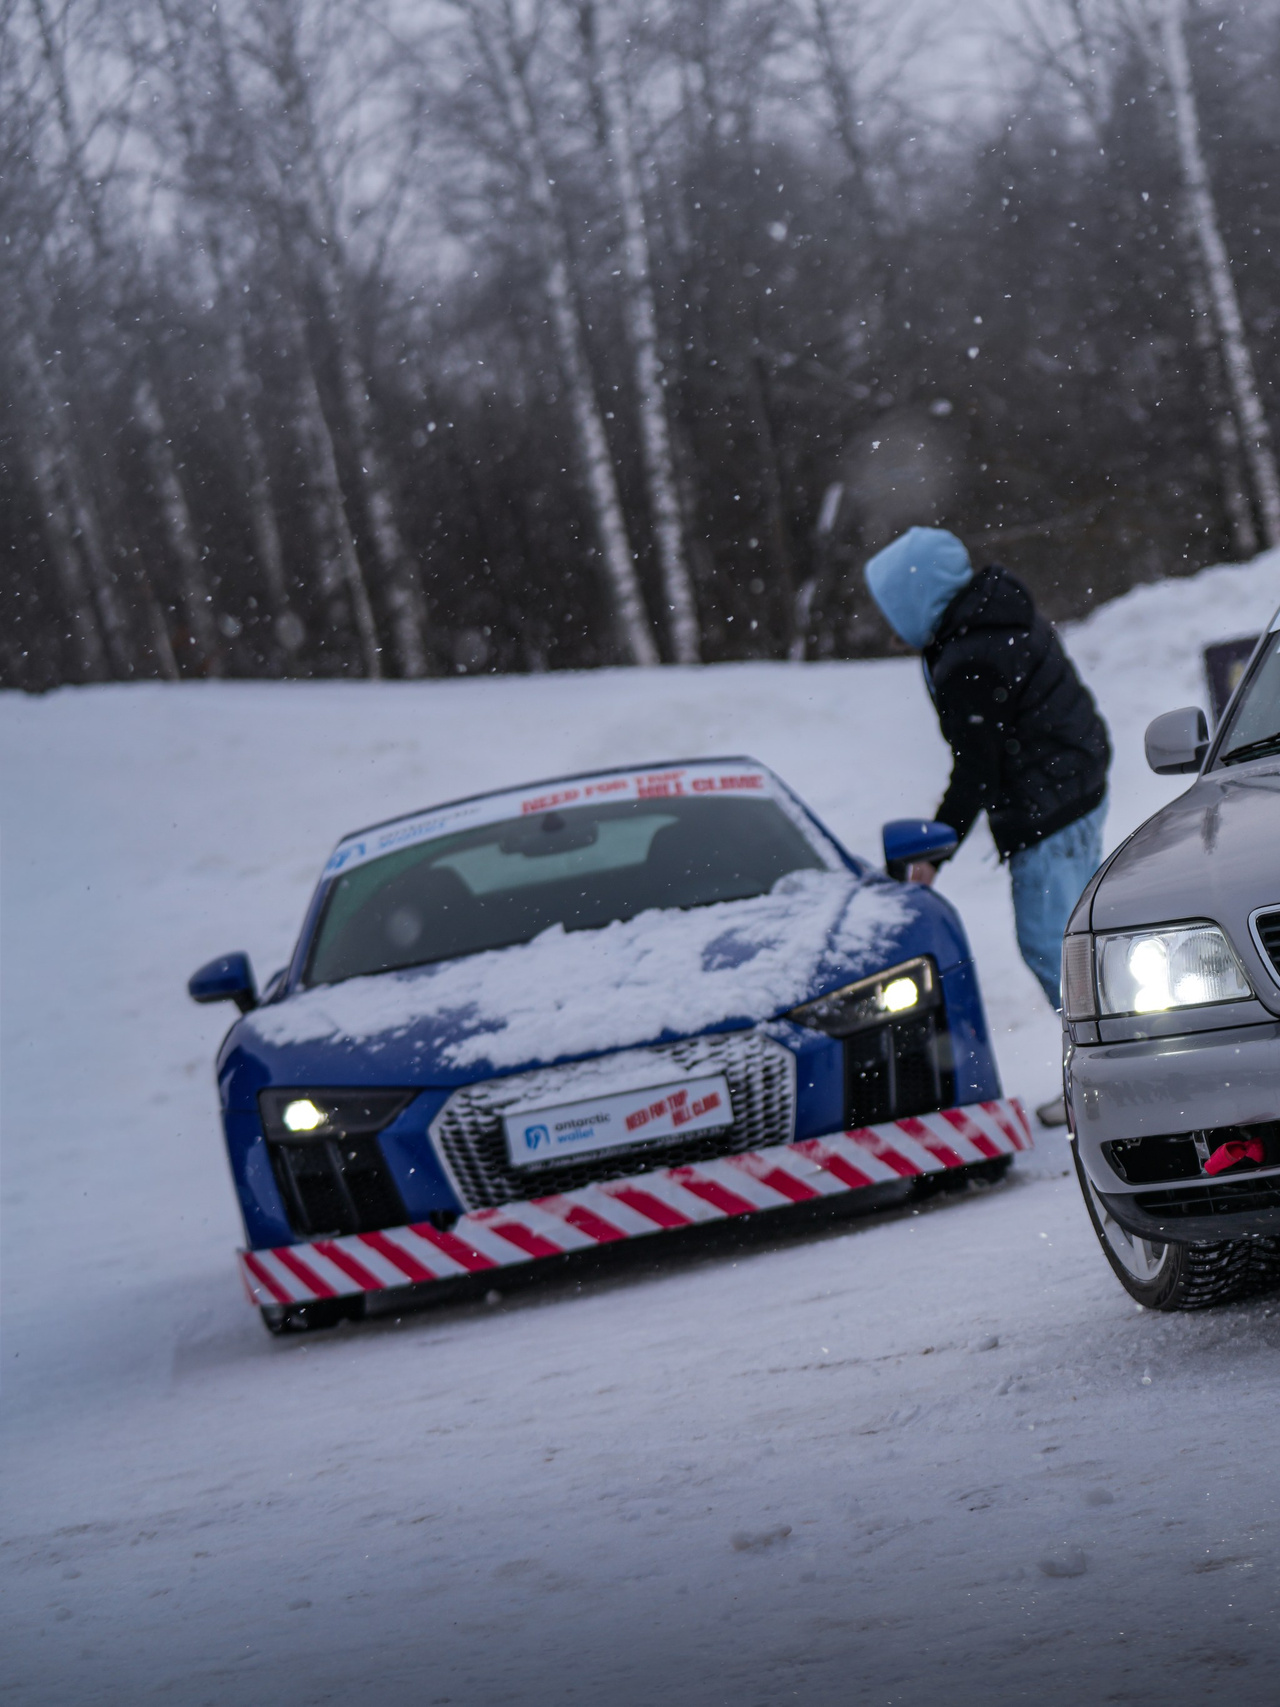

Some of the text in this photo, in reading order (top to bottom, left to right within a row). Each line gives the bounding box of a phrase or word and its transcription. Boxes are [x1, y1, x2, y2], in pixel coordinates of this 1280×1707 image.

[522, 789, 580, 815] NEED
[585, 780, 628, 797] FOR
[554, 1112, 611, 1132] antarctic
[557, 1127, 595, 1144] wallet
